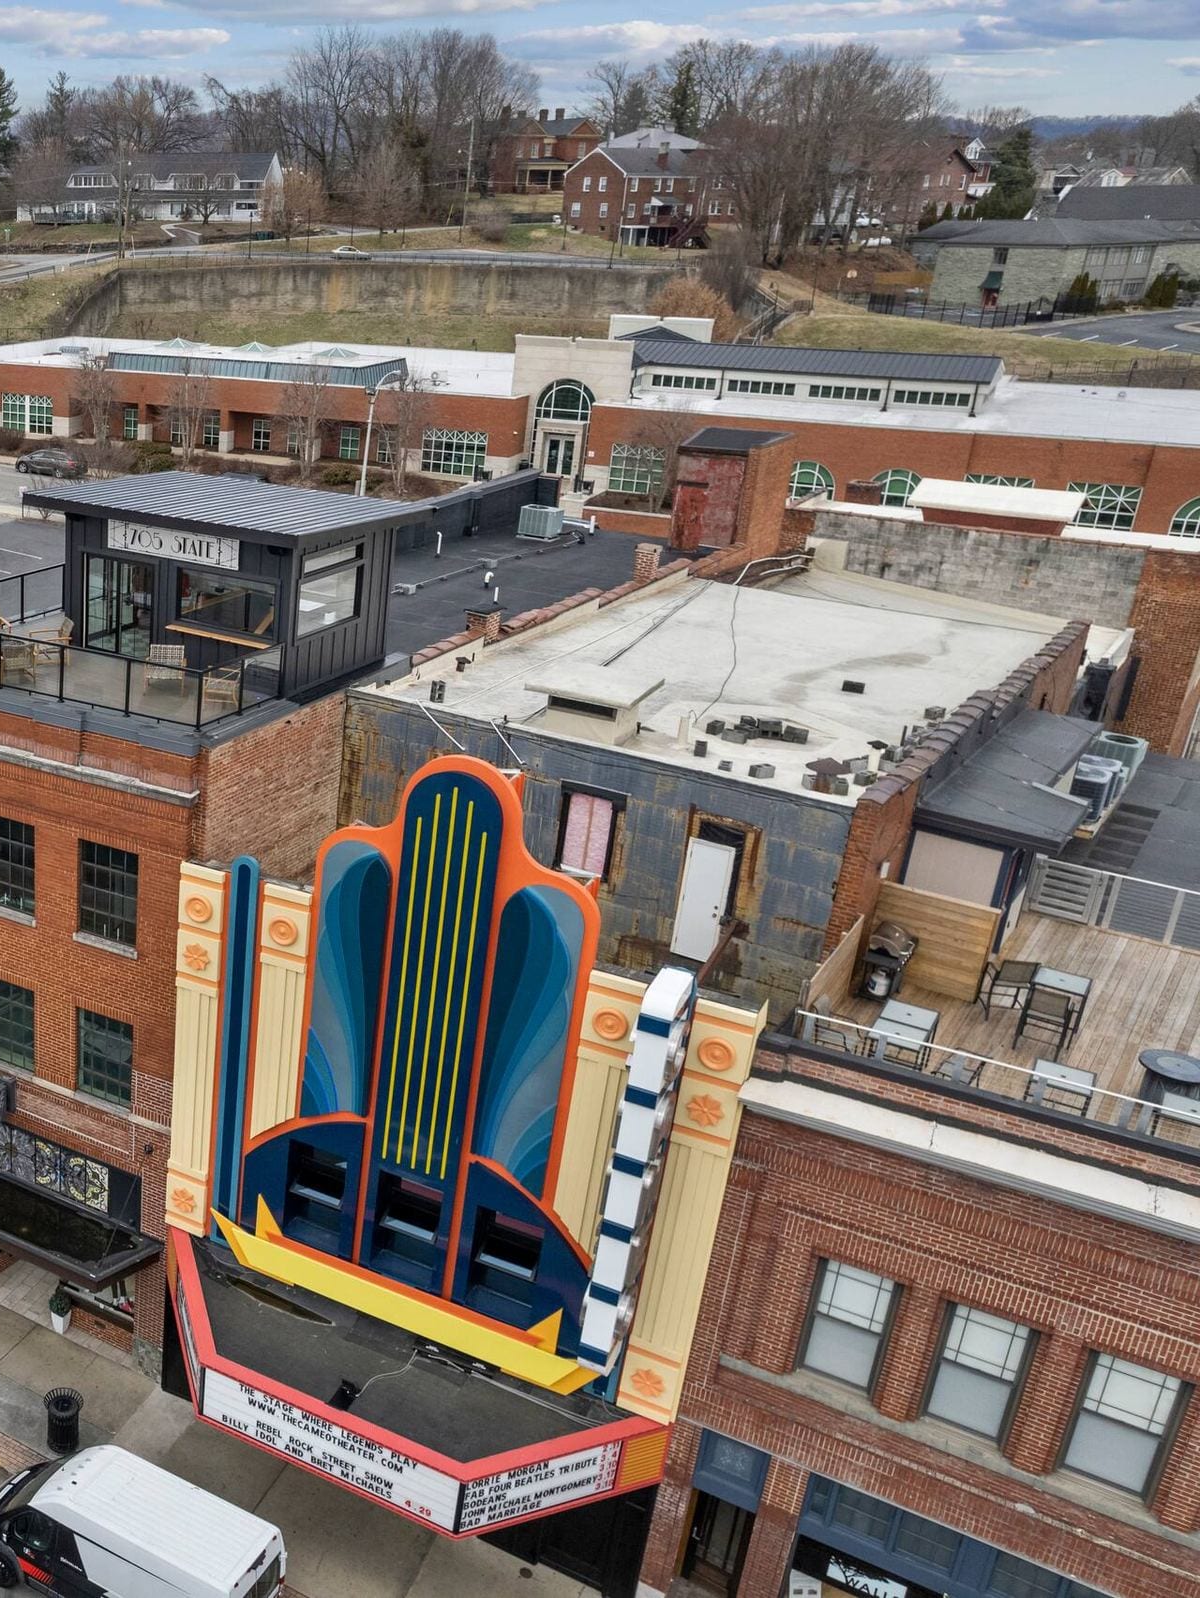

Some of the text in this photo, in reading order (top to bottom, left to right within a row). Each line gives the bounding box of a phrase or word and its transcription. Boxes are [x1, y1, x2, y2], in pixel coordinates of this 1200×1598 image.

[129, 529, 215, 559] 705 STATE
[239, 1384, 418, 1469] THE STAGE WHERE LEGENDS PLAY
[248, 1397, 404, 1474] WWW.THECAMEOTHEATER.COM
[222, 1414, 432, 1516] BILLY IDOL AND BRET MICHAELS 4.29
[256, 1421, 393, 1489] REBEL ROCK STREET SHOW
[466, 1474, 501, 1490] LORRIE
[508, 1461, 549, 1479] MORGAN
[462, 1507, 486, 1520] JOHN
[488, 1495, 531, 1515] MICHAEL
[534, 1475, 598, 1500] MONTGOMERY
[465, 1489, 485, 1500] FAB
[488, 1482, 512, 1495] FOUR
[515, 1469, 555, 1488] BEATLES
[559, 1457, 597, 1475] TRIBUTE
[459, 1518, 480, 1529] BAD
[487, 1501, 542, 1521] MARRIAGE
[463, 1493, 507, 1510] BODEANS
